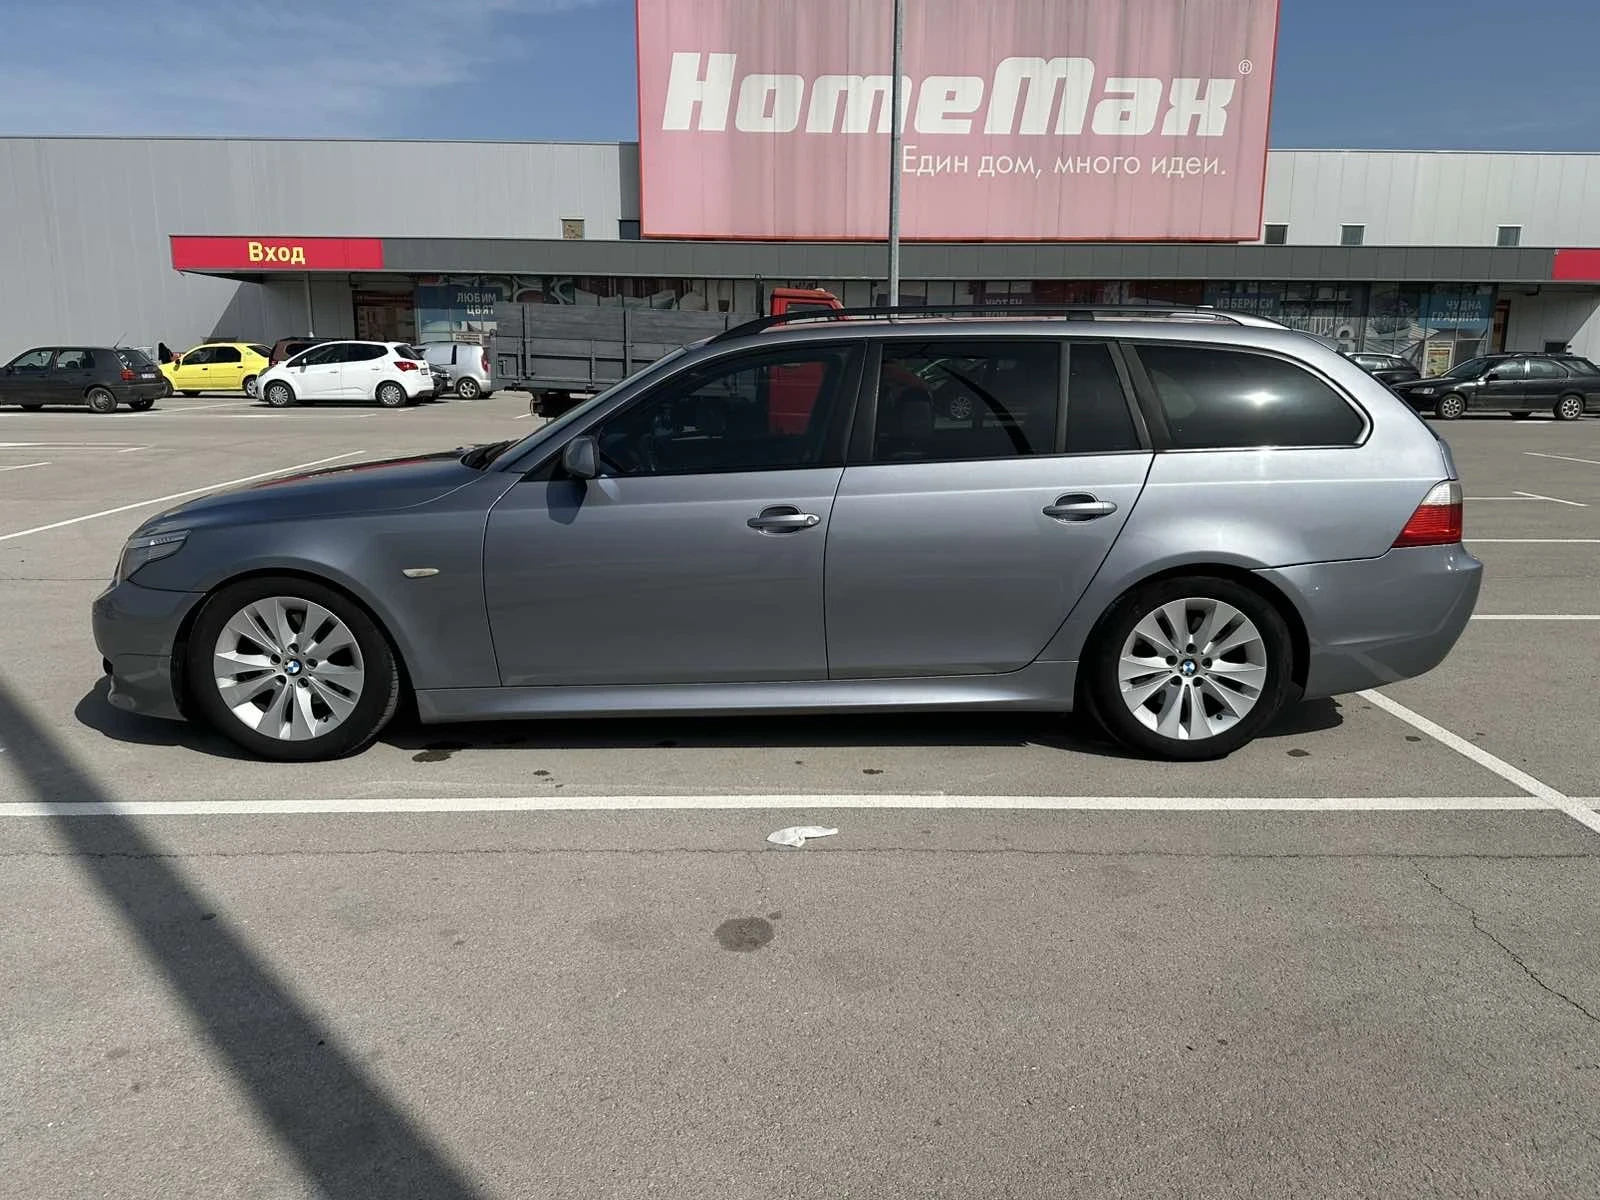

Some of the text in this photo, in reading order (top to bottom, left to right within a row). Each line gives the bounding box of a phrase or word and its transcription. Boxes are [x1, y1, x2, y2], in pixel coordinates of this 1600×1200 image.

[662, 52, 1236, 137] HomeMax
[902, 145, 1227, 179] Един дом, много идеи.
[248, 241, 306, 265] Вход
[456, 292, 497, 304] ЛЮБИМ
[467, 304, 494, 317] ЦВЯТ
